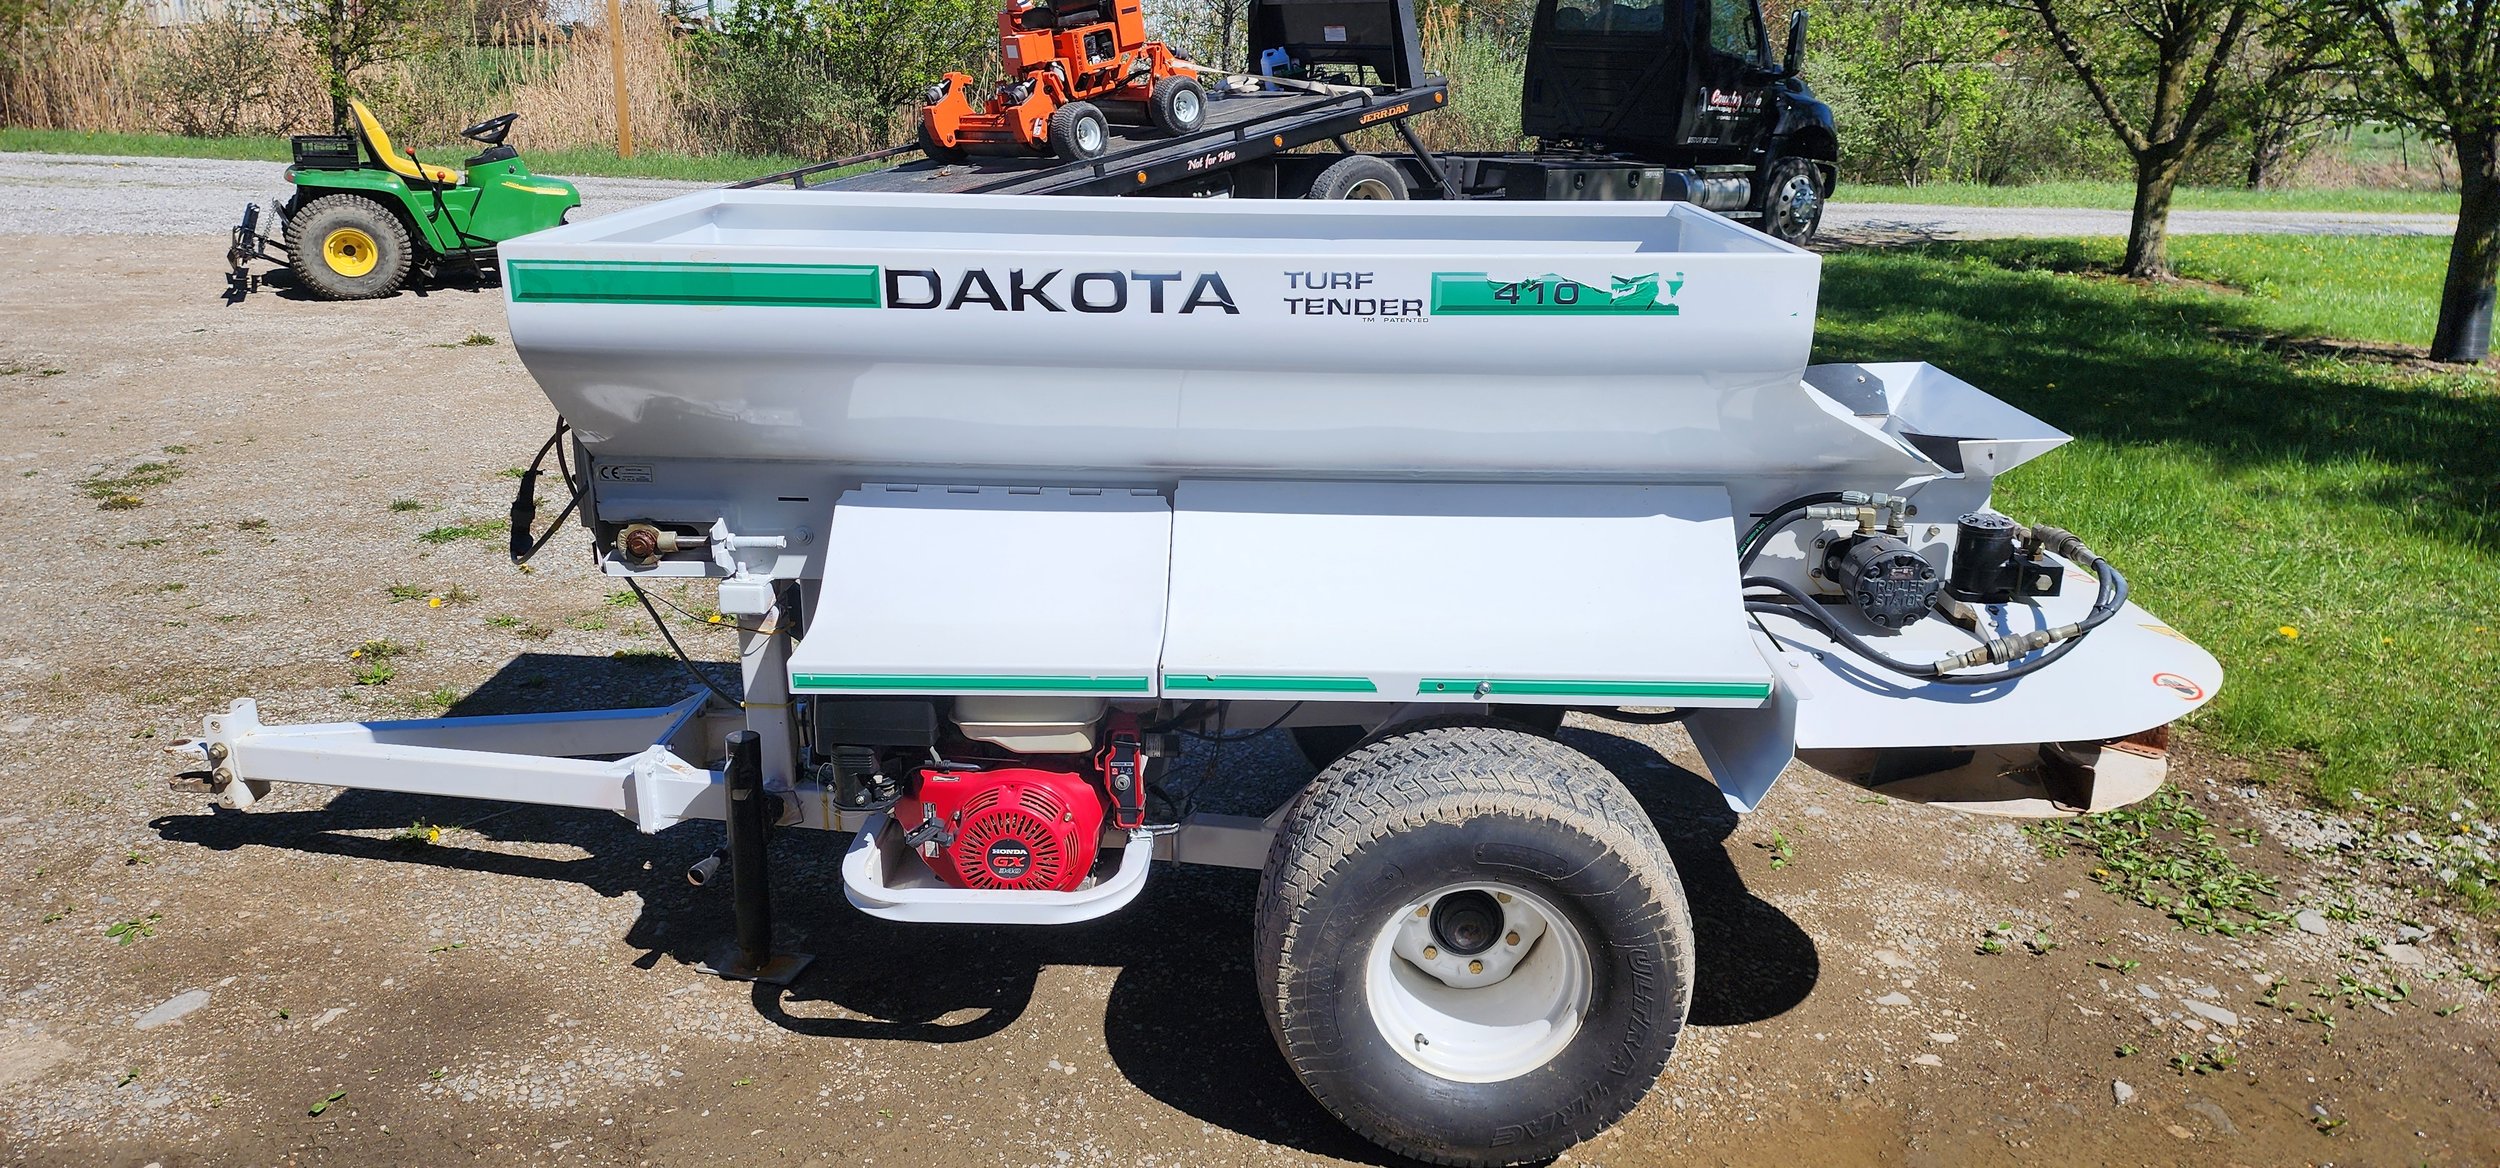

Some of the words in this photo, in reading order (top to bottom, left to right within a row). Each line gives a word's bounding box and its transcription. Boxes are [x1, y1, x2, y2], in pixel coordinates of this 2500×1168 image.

[1187, 157, 1204, 171] Not
[1205, 153, 1217, 169] for
[1217, 150, 1236, 163] Hire
[884, 265, 1240, 314] DAKOTA
[1284, 271, 1374, 290] TURF
[1494, 282, 1580, 305] 410
[1284, 298, 1424, 317] TENDER
[1876, 579, 1926, 593] ROLLER
[1875, 593, 1925, 608] STATOR
[993, 856, 1026, 867] GX
[1607, 948, 1655, 1077] ULTRA
